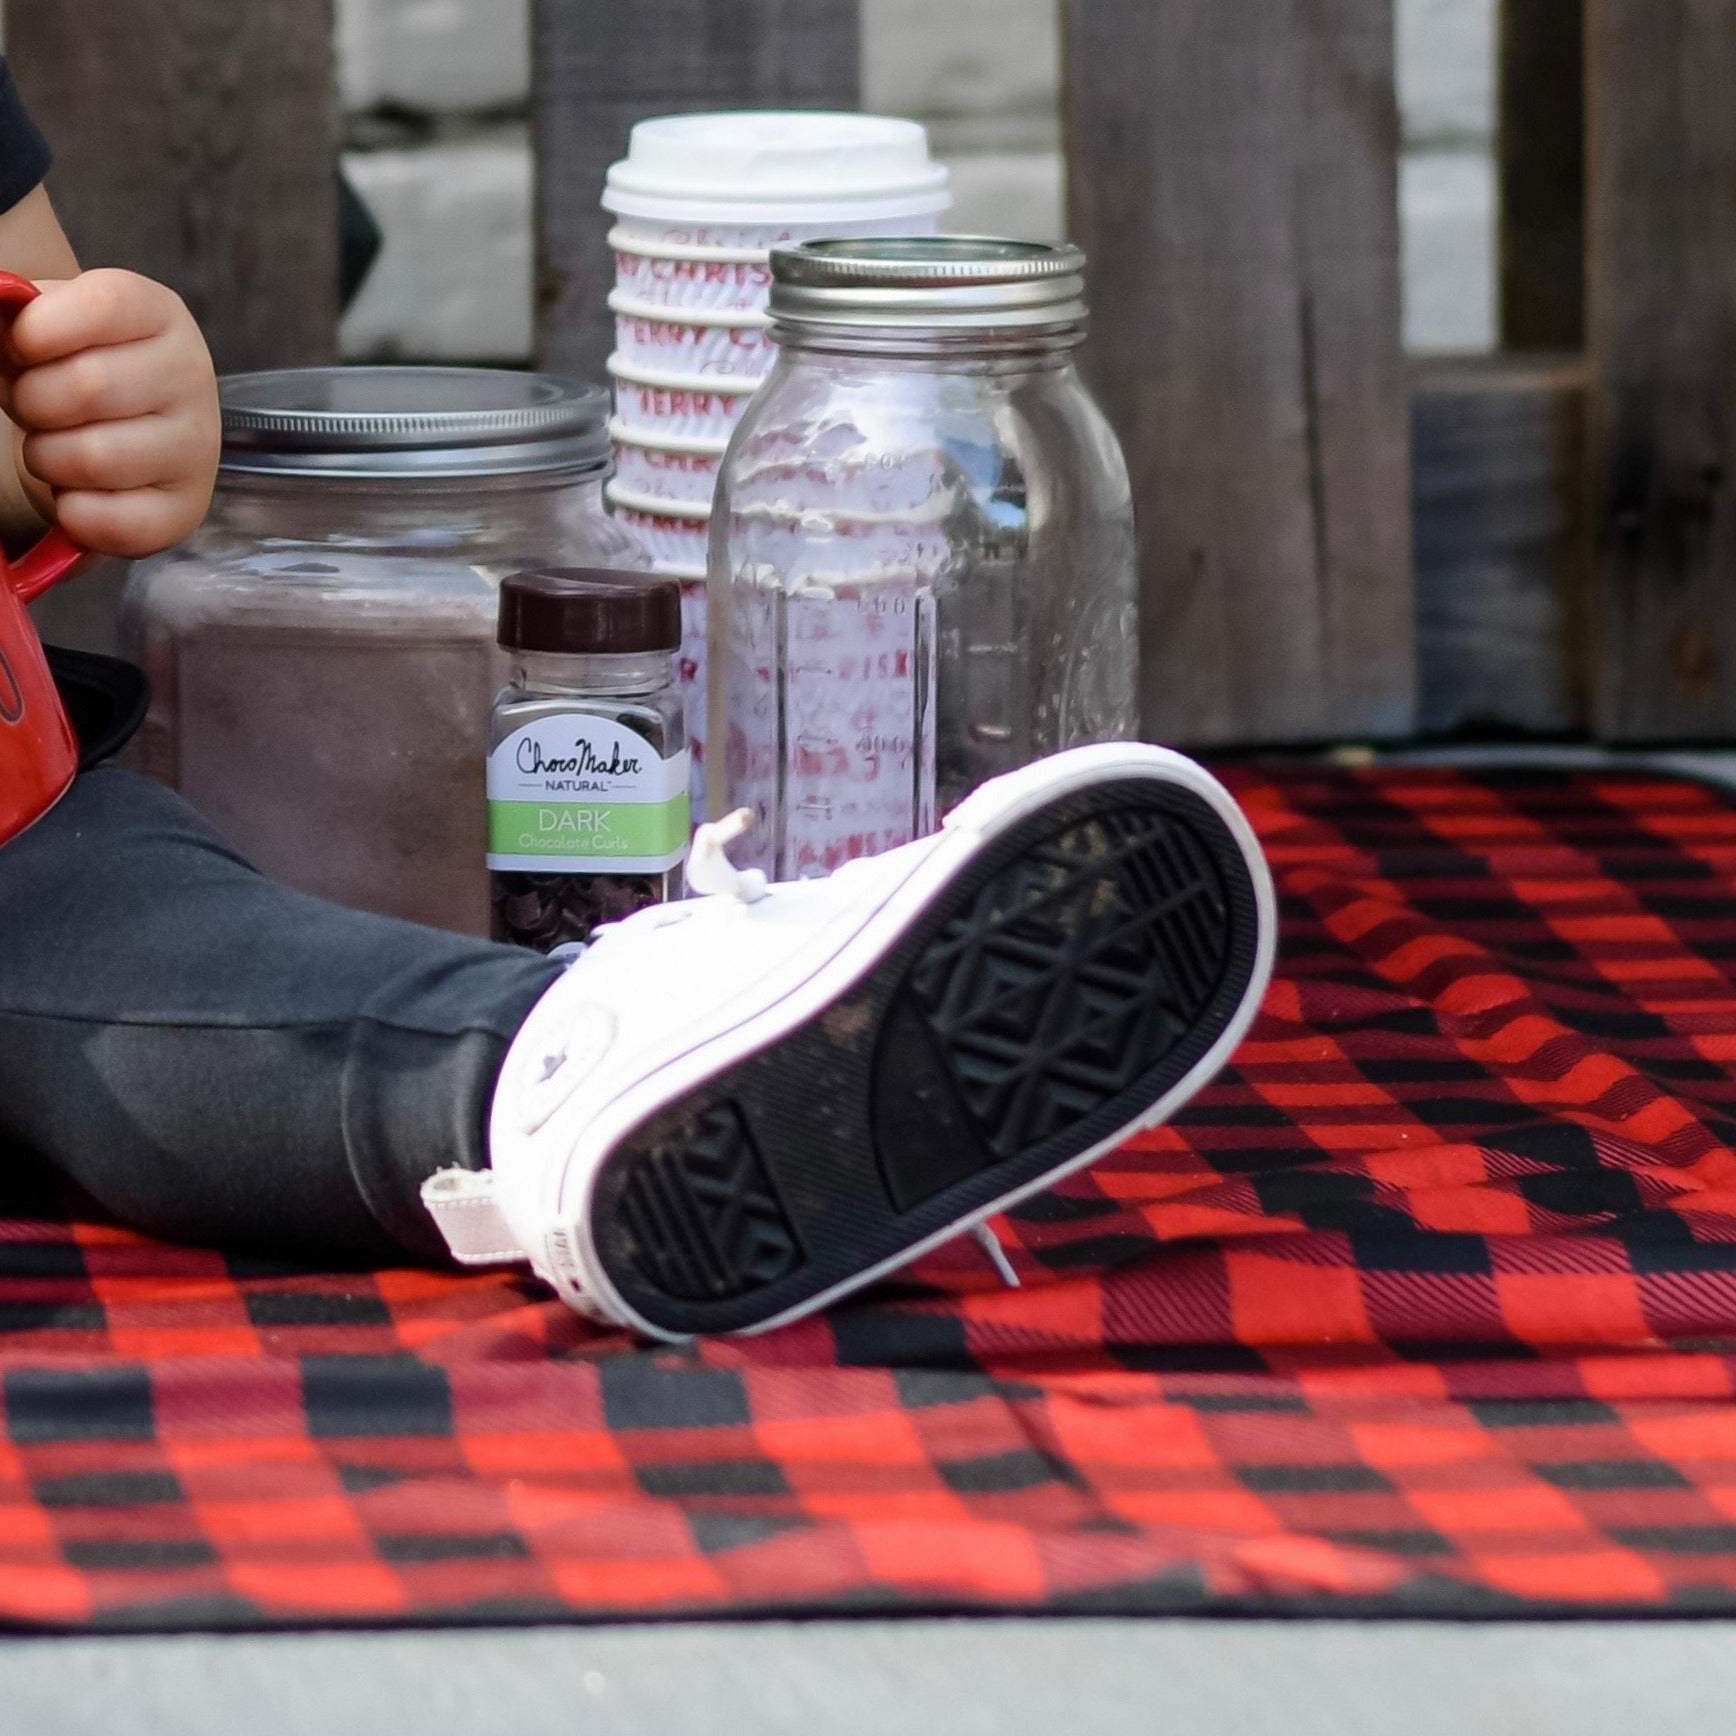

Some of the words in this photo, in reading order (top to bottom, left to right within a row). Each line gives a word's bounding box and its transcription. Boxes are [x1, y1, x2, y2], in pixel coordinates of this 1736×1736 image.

[545, 780, 609, 792] NATURAL
[539, 808, 612, 832] DARK
[518, 833, 588, 848] Chocolate
[591, 835, 629, 850] Curls
